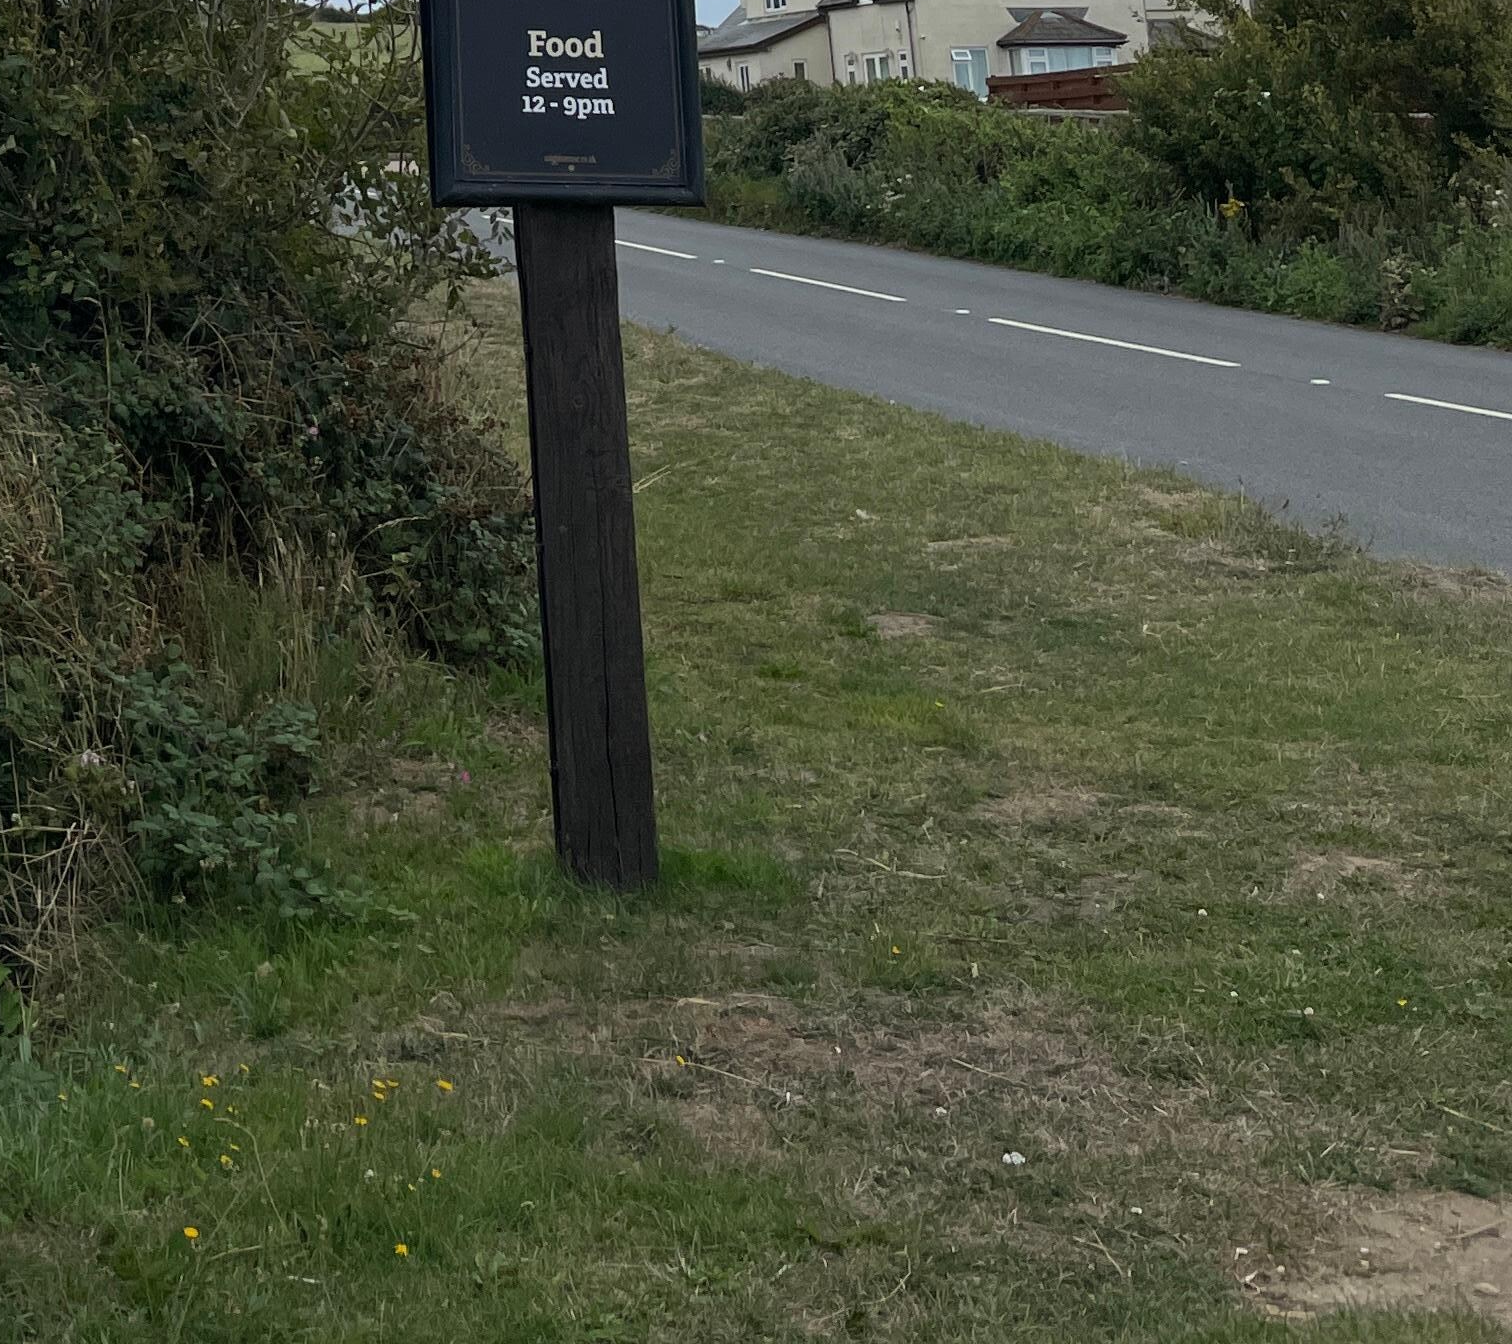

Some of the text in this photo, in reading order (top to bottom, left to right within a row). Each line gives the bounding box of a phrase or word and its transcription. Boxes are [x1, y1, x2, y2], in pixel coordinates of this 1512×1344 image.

[527, 30, 604, 59] Food
[525, 67, 609, 89] Served
[522, 95, 546, 114] 12
[563, 97, 616, 119] 9pm
